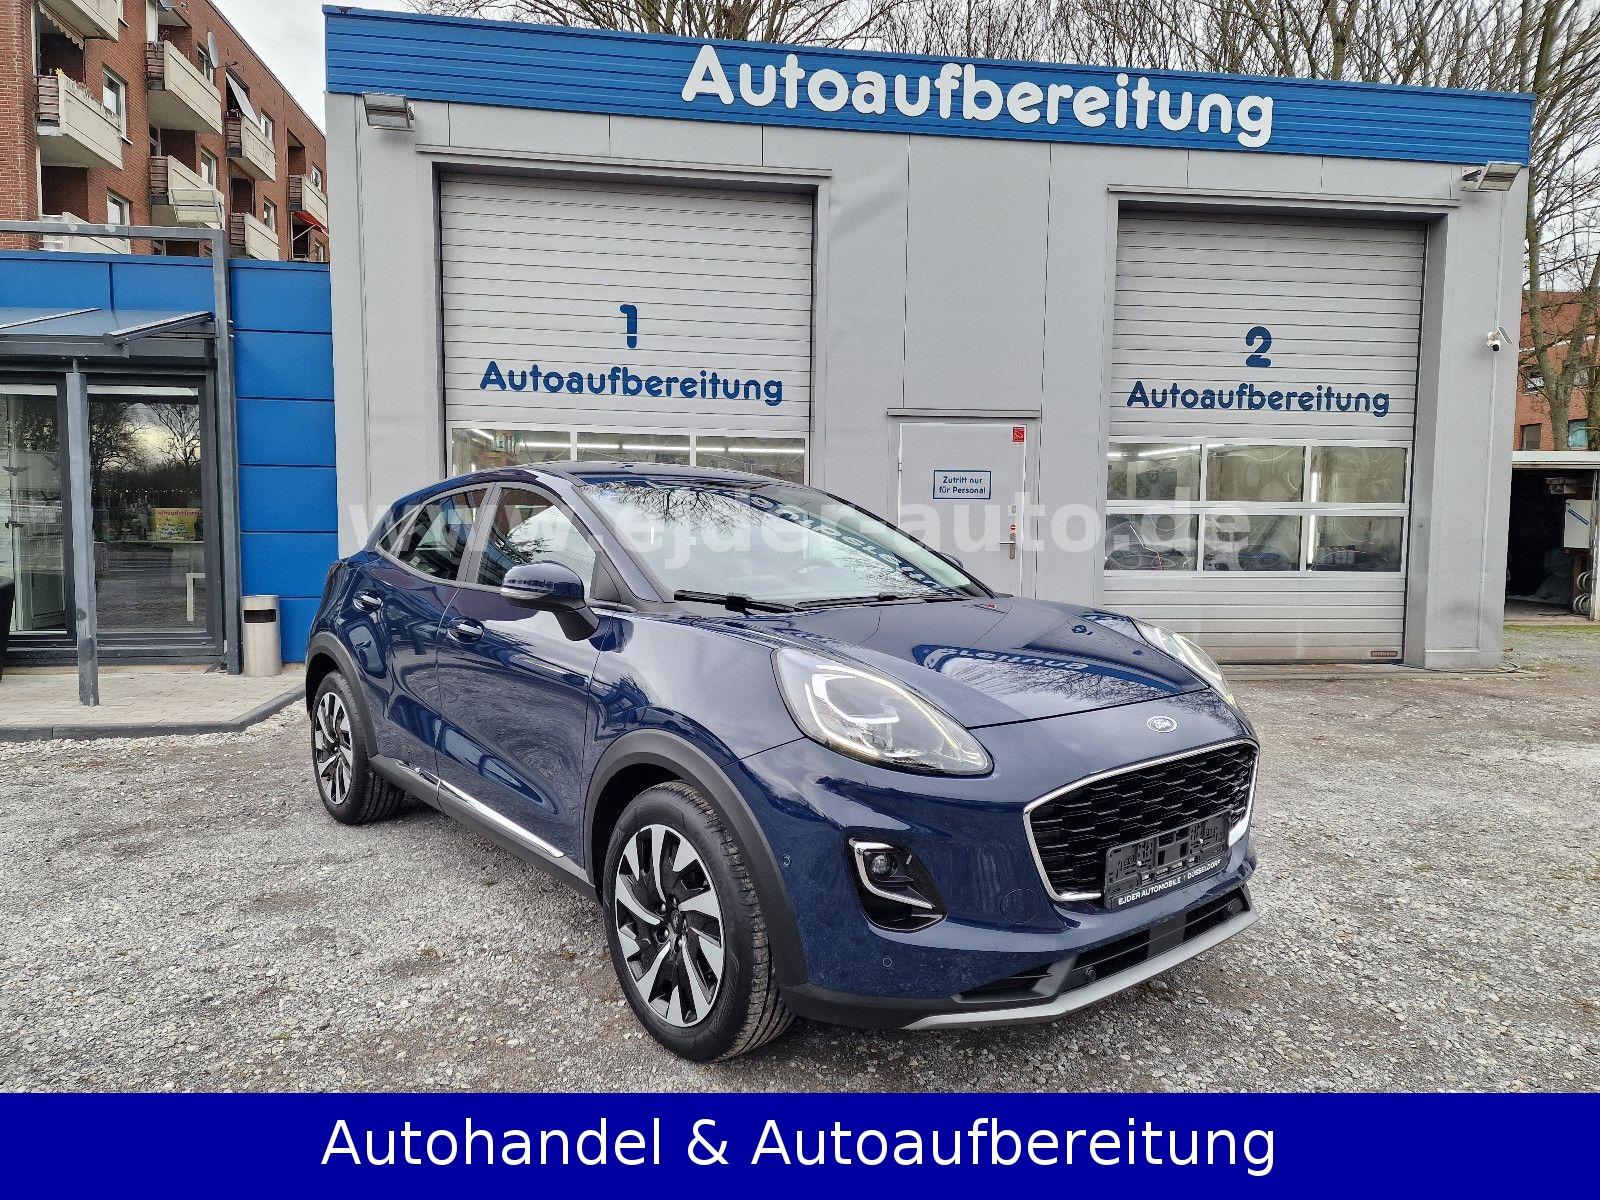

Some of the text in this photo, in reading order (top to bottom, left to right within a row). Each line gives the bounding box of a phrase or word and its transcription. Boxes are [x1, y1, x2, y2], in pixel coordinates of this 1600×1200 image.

[682, 45, 1274, 148] Autoaufbereitung
[619, 304, 638, 348] 1
[1245, 326, 1273, 368] 2
[480, 360, 783, 406] Autoaufbereitung
[1126, 380, 1390, 418] Autoaufbereitung
[939, 485, 986, 494] für Personal
[942, 475, 967, 484] Zutritt
[1118, 891, 1141, 906] EJDER
